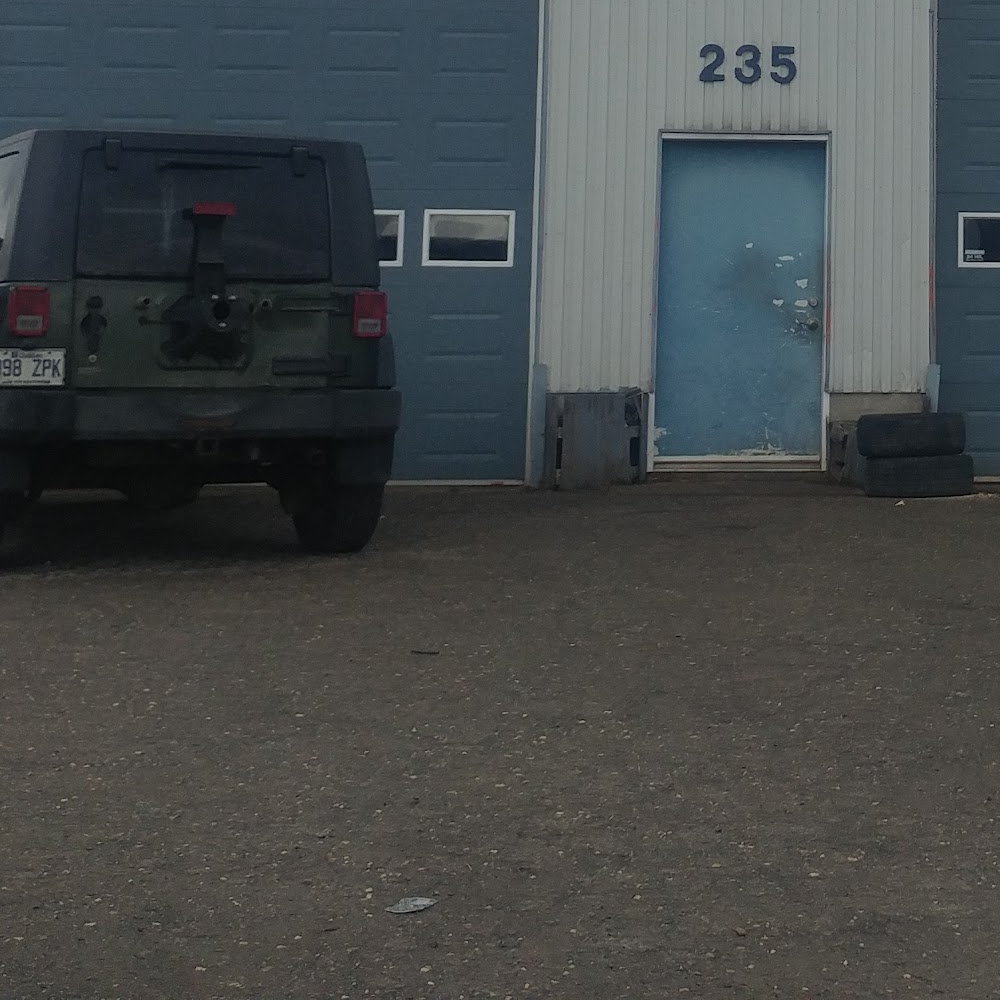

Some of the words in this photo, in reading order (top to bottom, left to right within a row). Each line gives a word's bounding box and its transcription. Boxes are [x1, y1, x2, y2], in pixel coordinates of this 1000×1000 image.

[699, 43, 798, 85] 235
[0, 358, 22, 377] 98
[32, 358, 61, 378] ZPK
